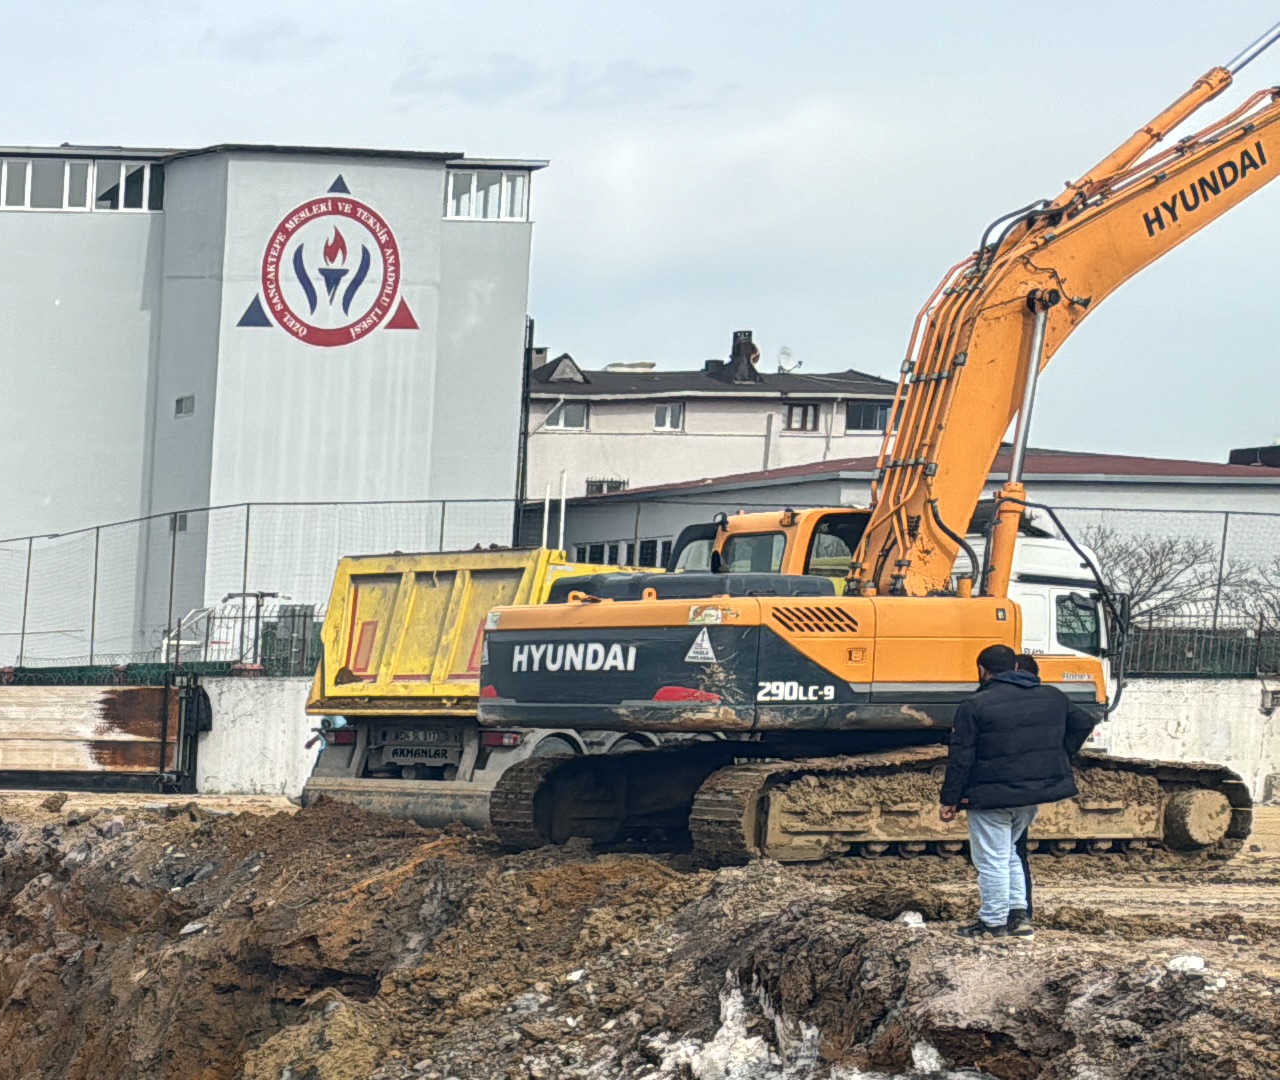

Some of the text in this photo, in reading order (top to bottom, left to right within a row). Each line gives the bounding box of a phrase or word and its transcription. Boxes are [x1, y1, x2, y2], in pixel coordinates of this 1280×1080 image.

[1143, 141, 1267, 238] HYUNDAI
[284, 199, 333, 232] MESLEKİ
[337, 201, 353, 214] VE
[356, 207, 390, 245] TEKNİK
[266, 231, 287, 311] SANCAKTEPE
[381, 248, 396, 307] ANADOLU
[283, 311, 308, 338] ÖZEL
[512, 643, 637, 673] HYUNDAI
[391, 748, 448, 760] AKMANLAR
